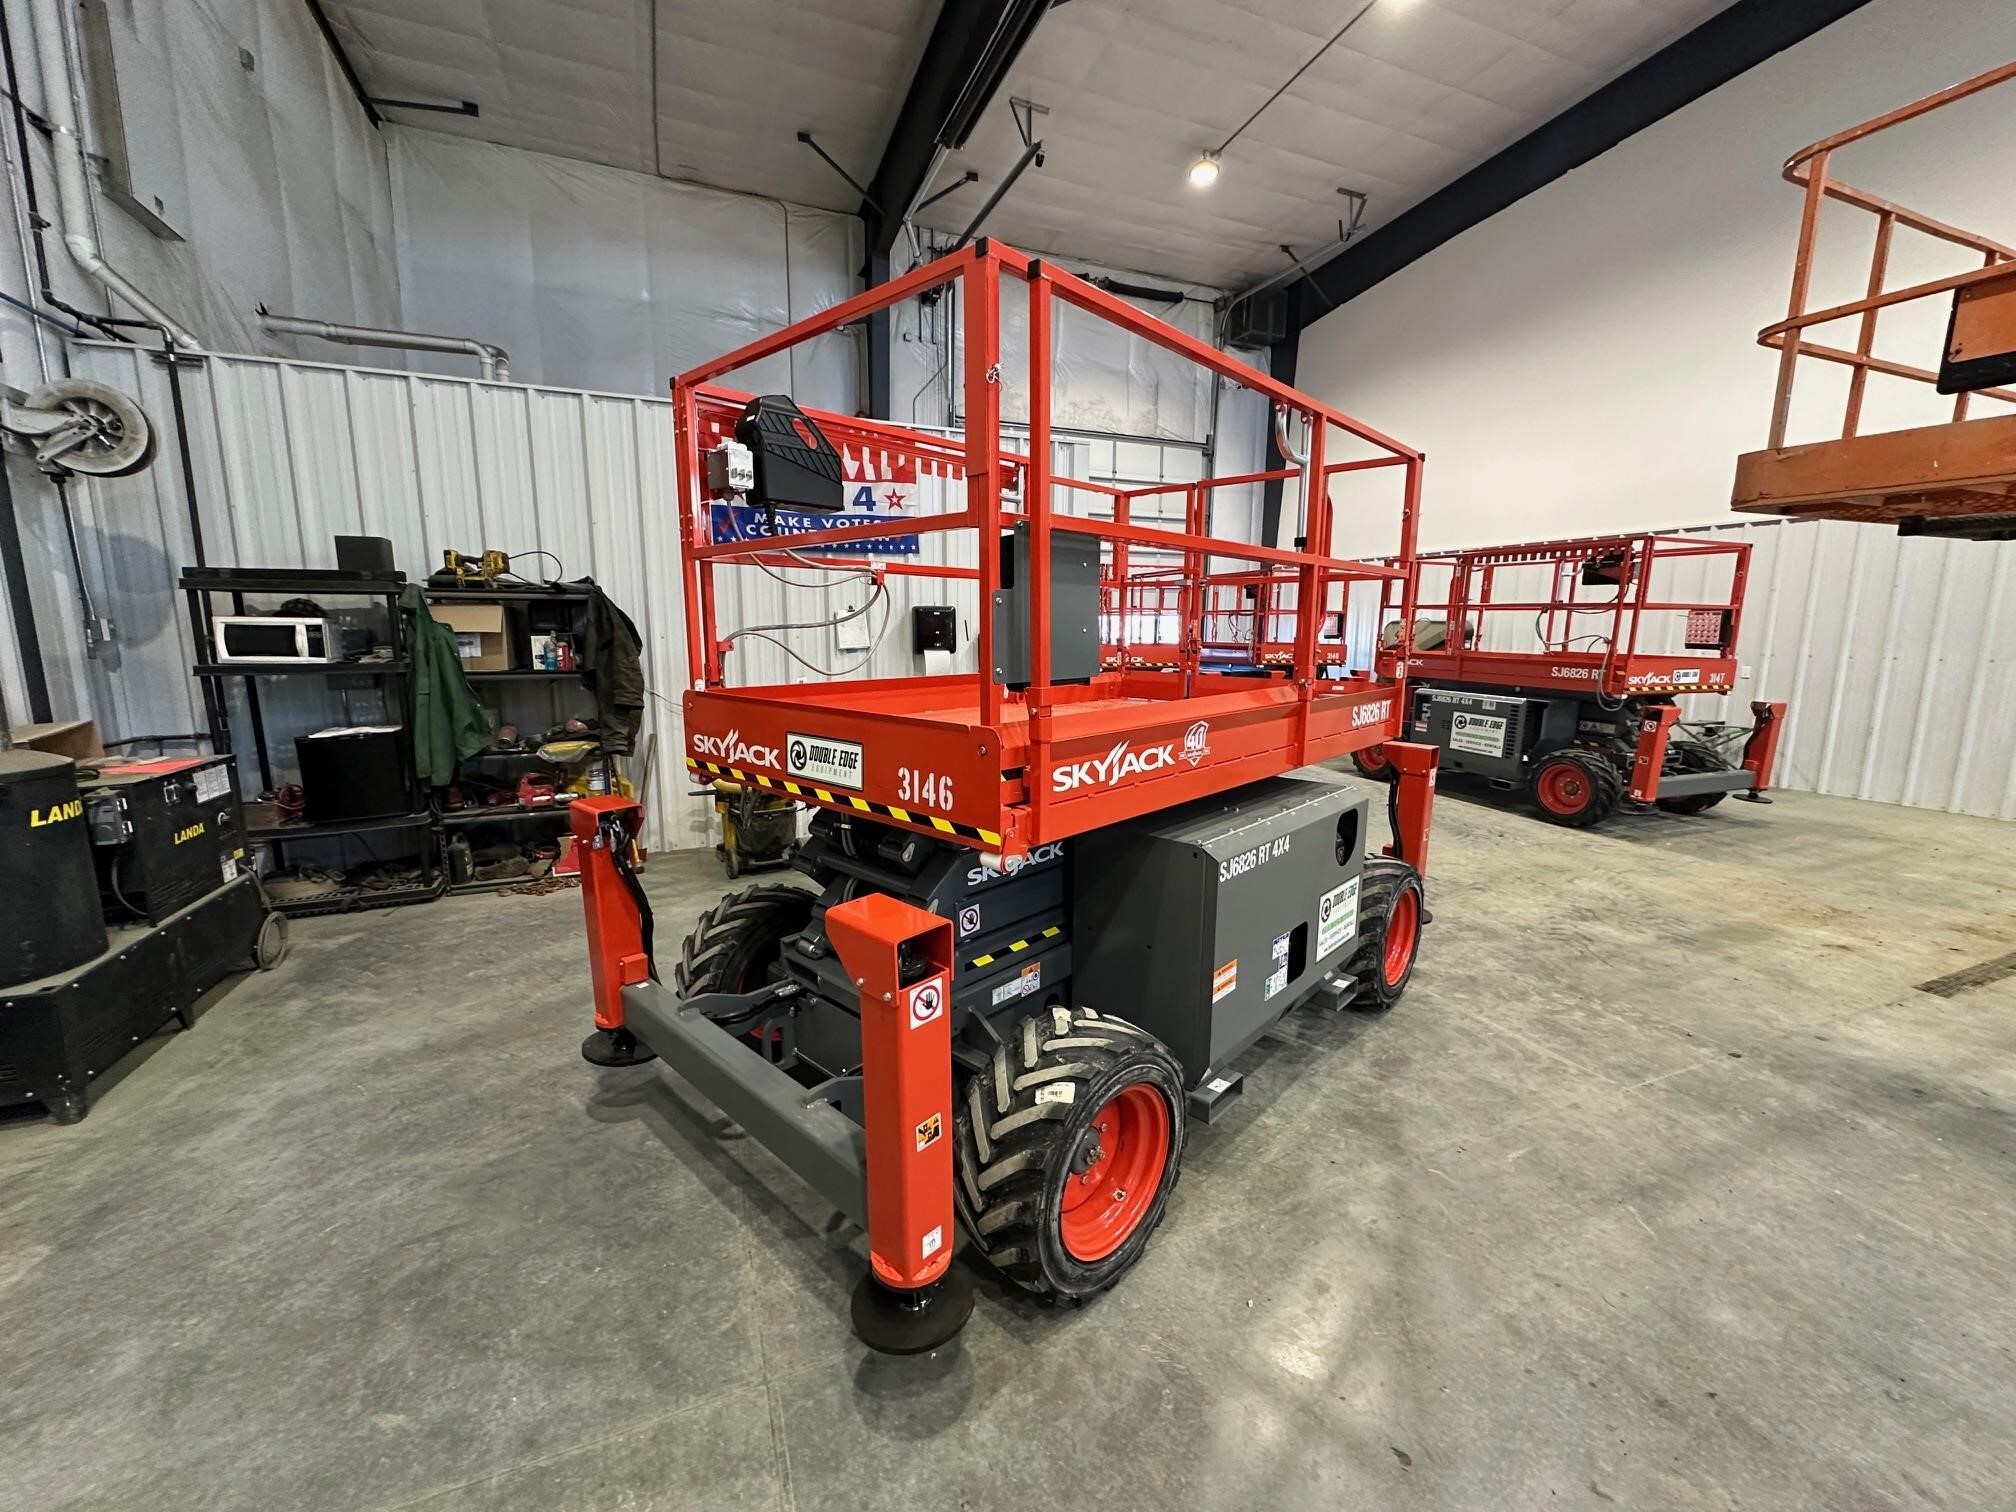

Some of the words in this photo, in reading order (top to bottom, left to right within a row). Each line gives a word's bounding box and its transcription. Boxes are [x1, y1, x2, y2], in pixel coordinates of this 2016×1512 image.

[754, 512, 811, 528] MAKE
[1551, 666, 1589, 679] SJ6826
[1628, 671, 1671, 686] SKYJACK
[1708, 672, 1726, 684] 3147
[1351, 702, 1380, 727] SJ6826
[1380, 699, 1392, 721] RT
[693, 728, 782, 770] SKYJACK
[1186, 726, 1205, 750] 40
[808, 744, 838, 766] DOUBLE
[838, 750, 859, 770] EDGE
[1052, 740, 1176, 793] SKYJACK
[811, 763, 852, 779] EQUIPMENT
[897, 767, 954, 811] 3146
[174, 822, 206, 845] LANDA
[967, 841, 1064, 886] SKACK
[1218, 852, 1257, 883] SJ6826
[1258, 843, 1270, 864] RT
[1272, 834, 1290, 858] 4X4
